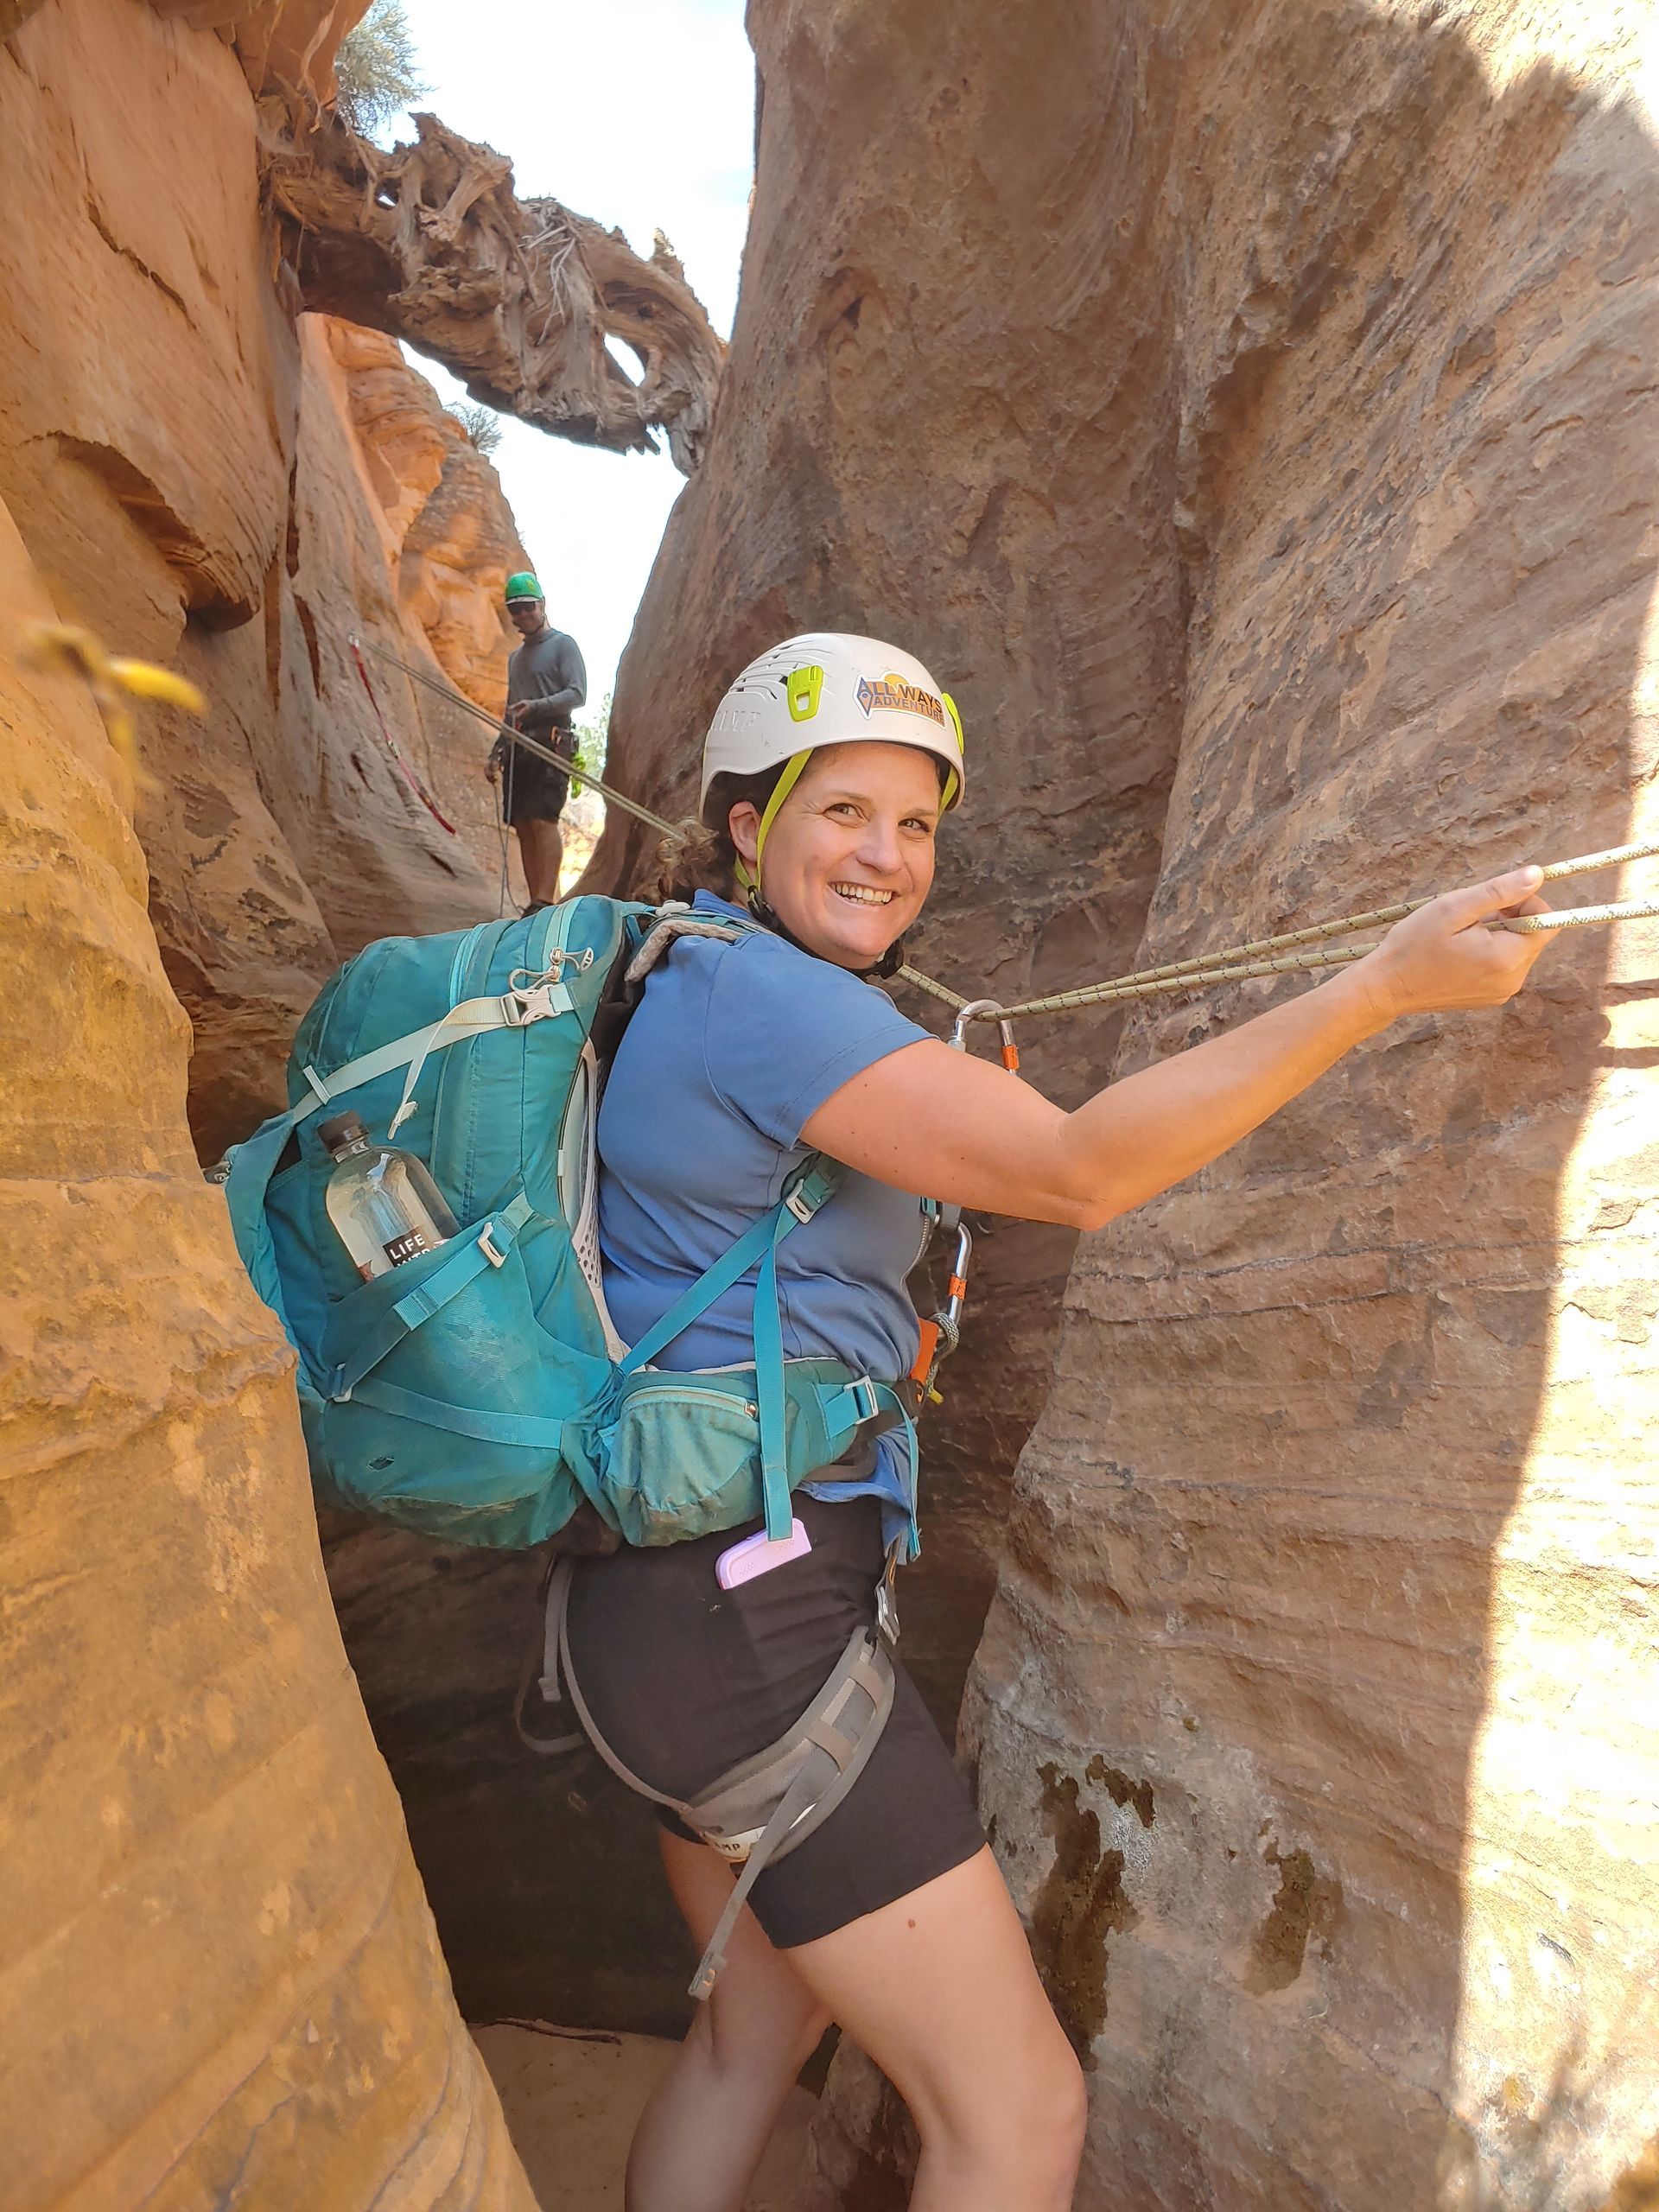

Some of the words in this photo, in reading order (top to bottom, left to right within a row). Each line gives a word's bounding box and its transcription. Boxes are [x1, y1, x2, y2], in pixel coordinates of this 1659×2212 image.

[856, 677, 896, 699] ALL
[898, 683, 943, 714] WAYS
[874, 696, 945, 724] ADVENTURE
[389, 1233, 426, 1260] LIFE
